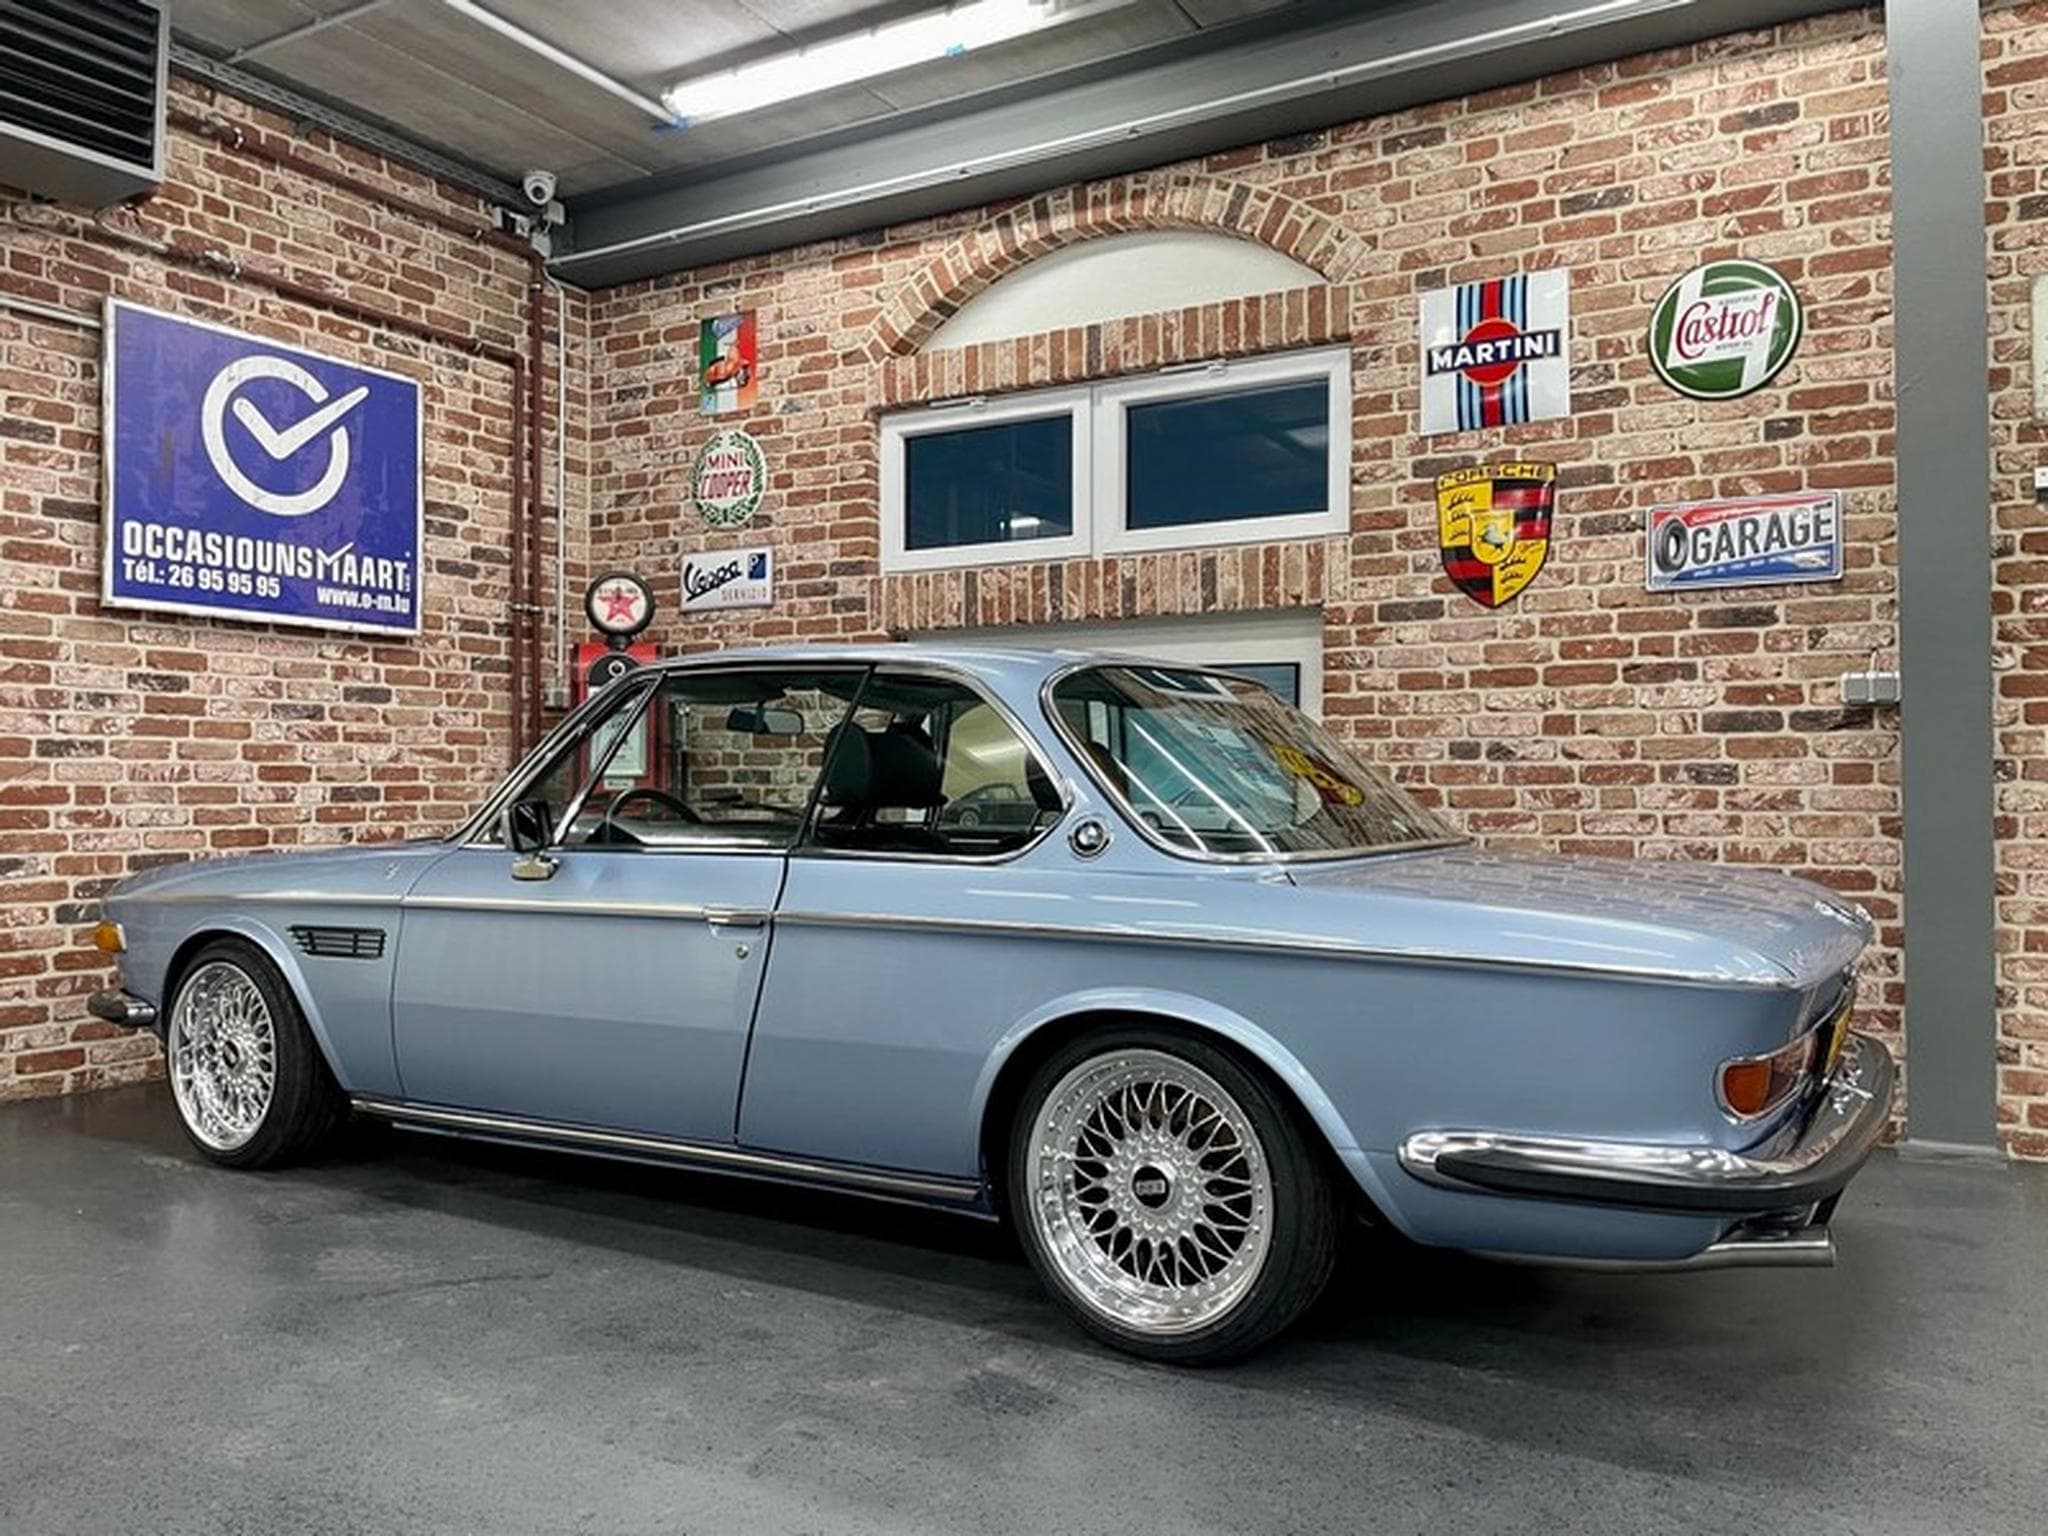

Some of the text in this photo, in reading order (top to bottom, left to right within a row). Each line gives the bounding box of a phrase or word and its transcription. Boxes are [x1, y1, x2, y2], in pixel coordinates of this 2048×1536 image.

[1676, 292, 1774, 360] Castrol
[1431, 333, 1554, 373] MARTINI
[705, 451, 743, 470] MINI
[700, 470, 751, 499] COOPER
[1692, 501, 1833, 566] GARAGE
[122, 520, 407, 591] OCCASIOUNSMAART
[168, 564, 194, 588] 26
[198, 567, 224, 592] 95
[227, 571, 253, 595] 95
[256, 575, 280, 598] 95
[317, 586, 410, 613] www.o-m.lu
[684, 562, 742, 602] Vespa
